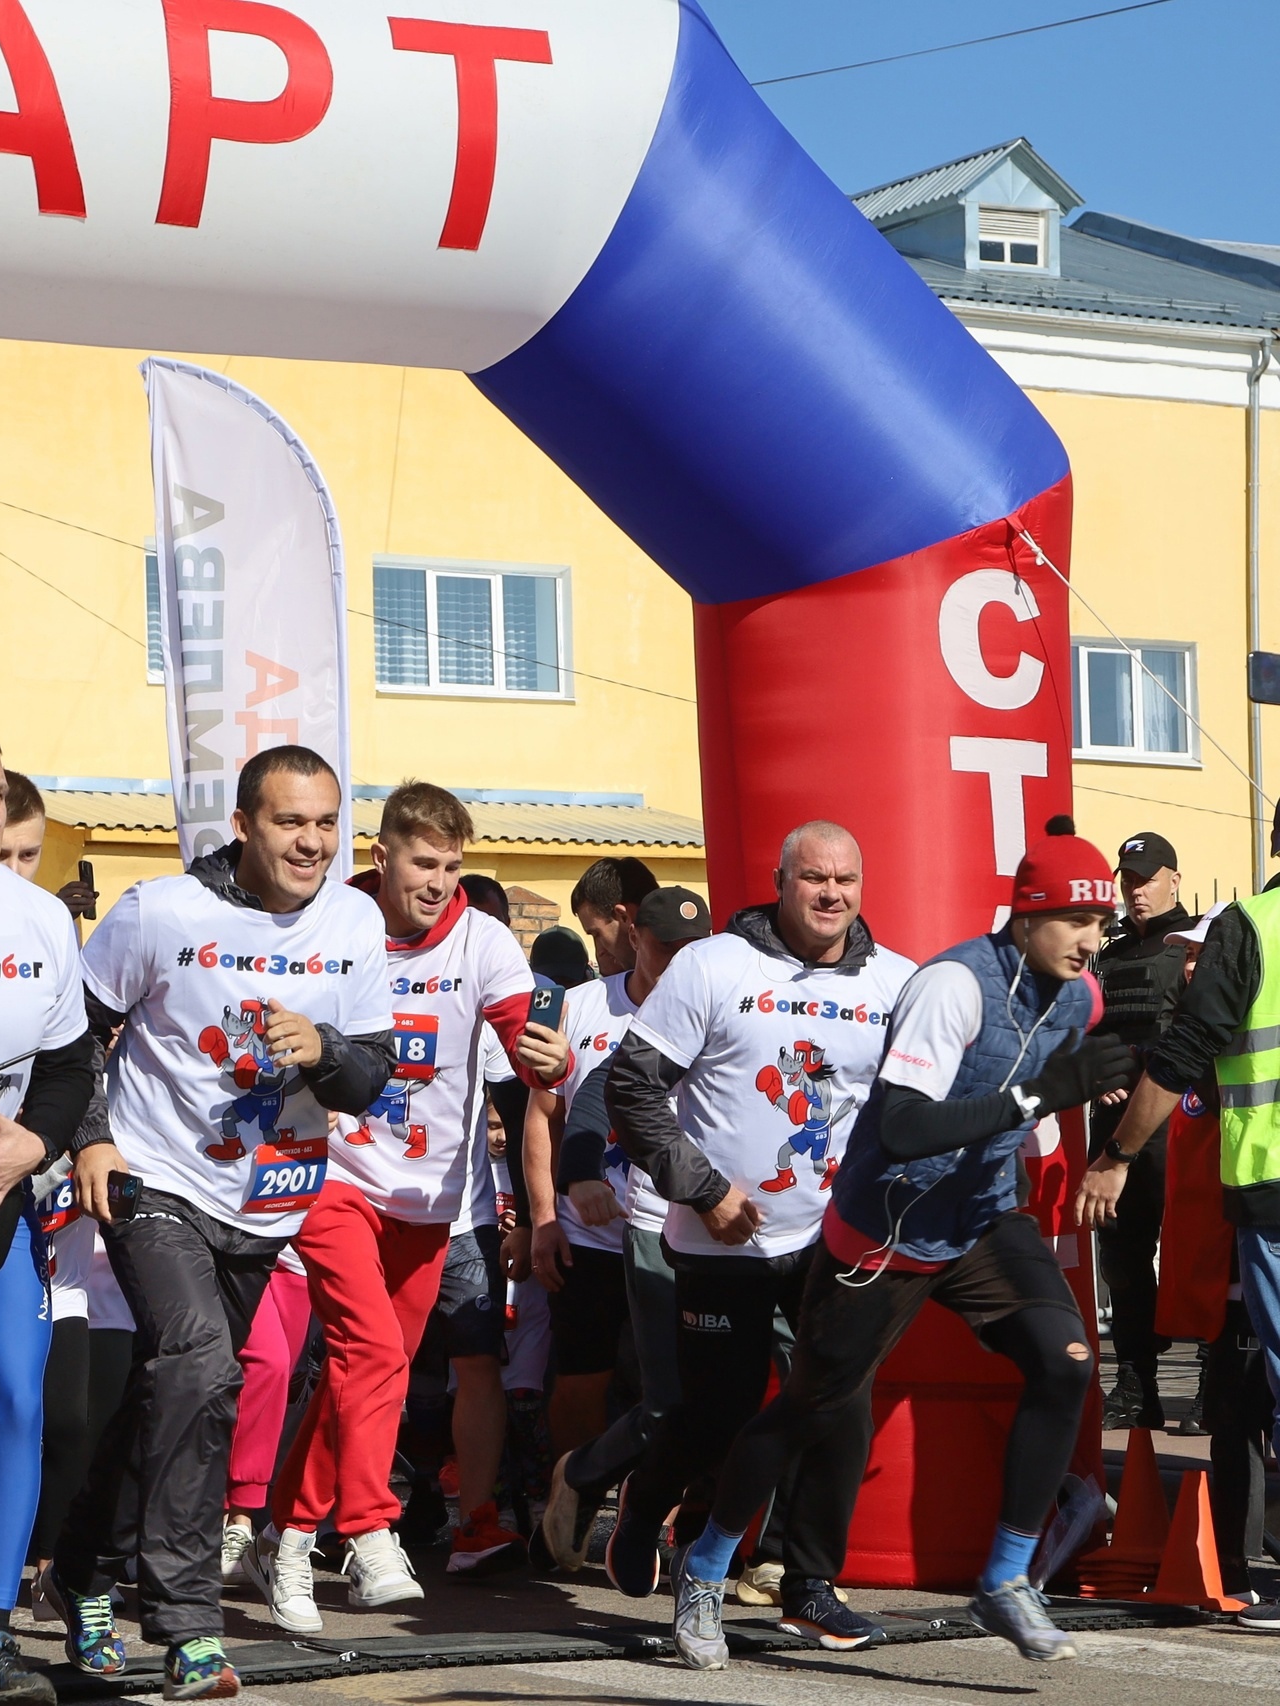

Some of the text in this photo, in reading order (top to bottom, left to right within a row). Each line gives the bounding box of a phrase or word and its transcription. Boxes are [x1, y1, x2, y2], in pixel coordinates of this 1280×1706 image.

[177, 942, 353, 975] #боксЗабег
[389, 975, 462, 995] Забег
[257, 1164, 318, 1197] 2901
[699, 1313, 731, 1328] IBA
